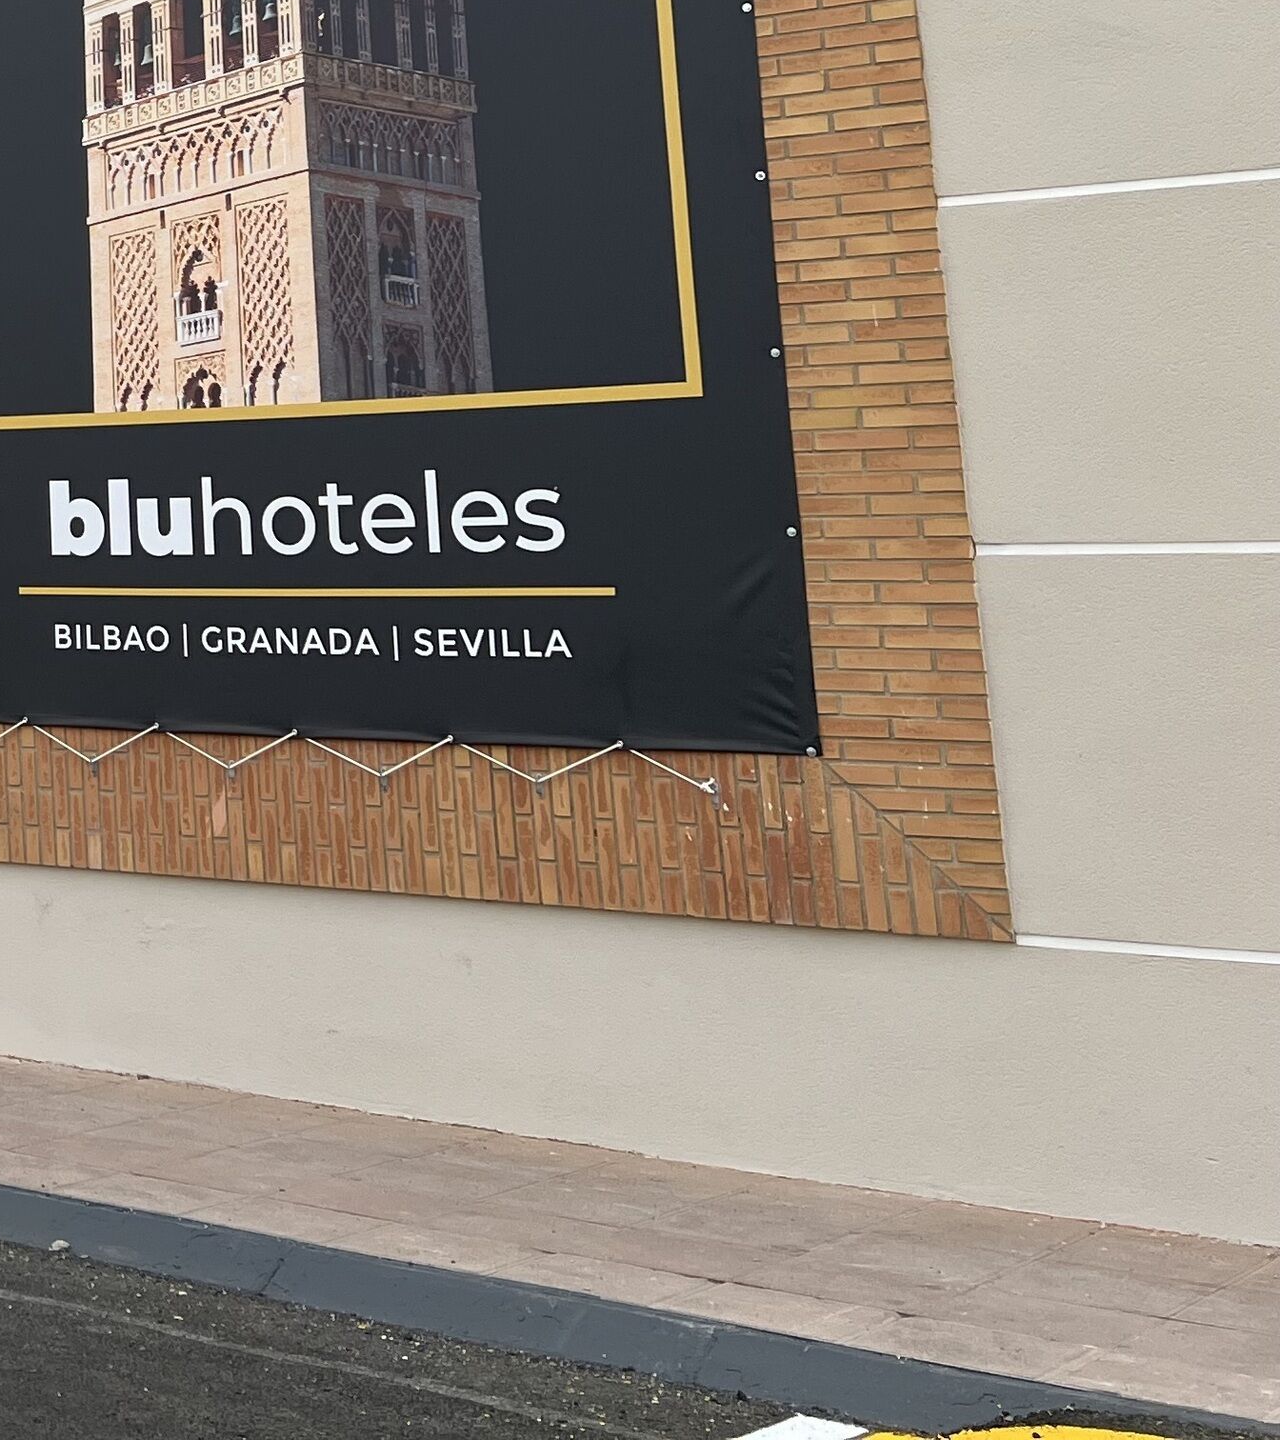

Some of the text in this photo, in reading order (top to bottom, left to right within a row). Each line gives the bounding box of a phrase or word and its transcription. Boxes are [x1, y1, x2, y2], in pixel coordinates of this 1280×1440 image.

[48, 468, 567, 557] bluhoteles
[53, 623, 573, 659] BILBAO GRANADA SEVILLA
